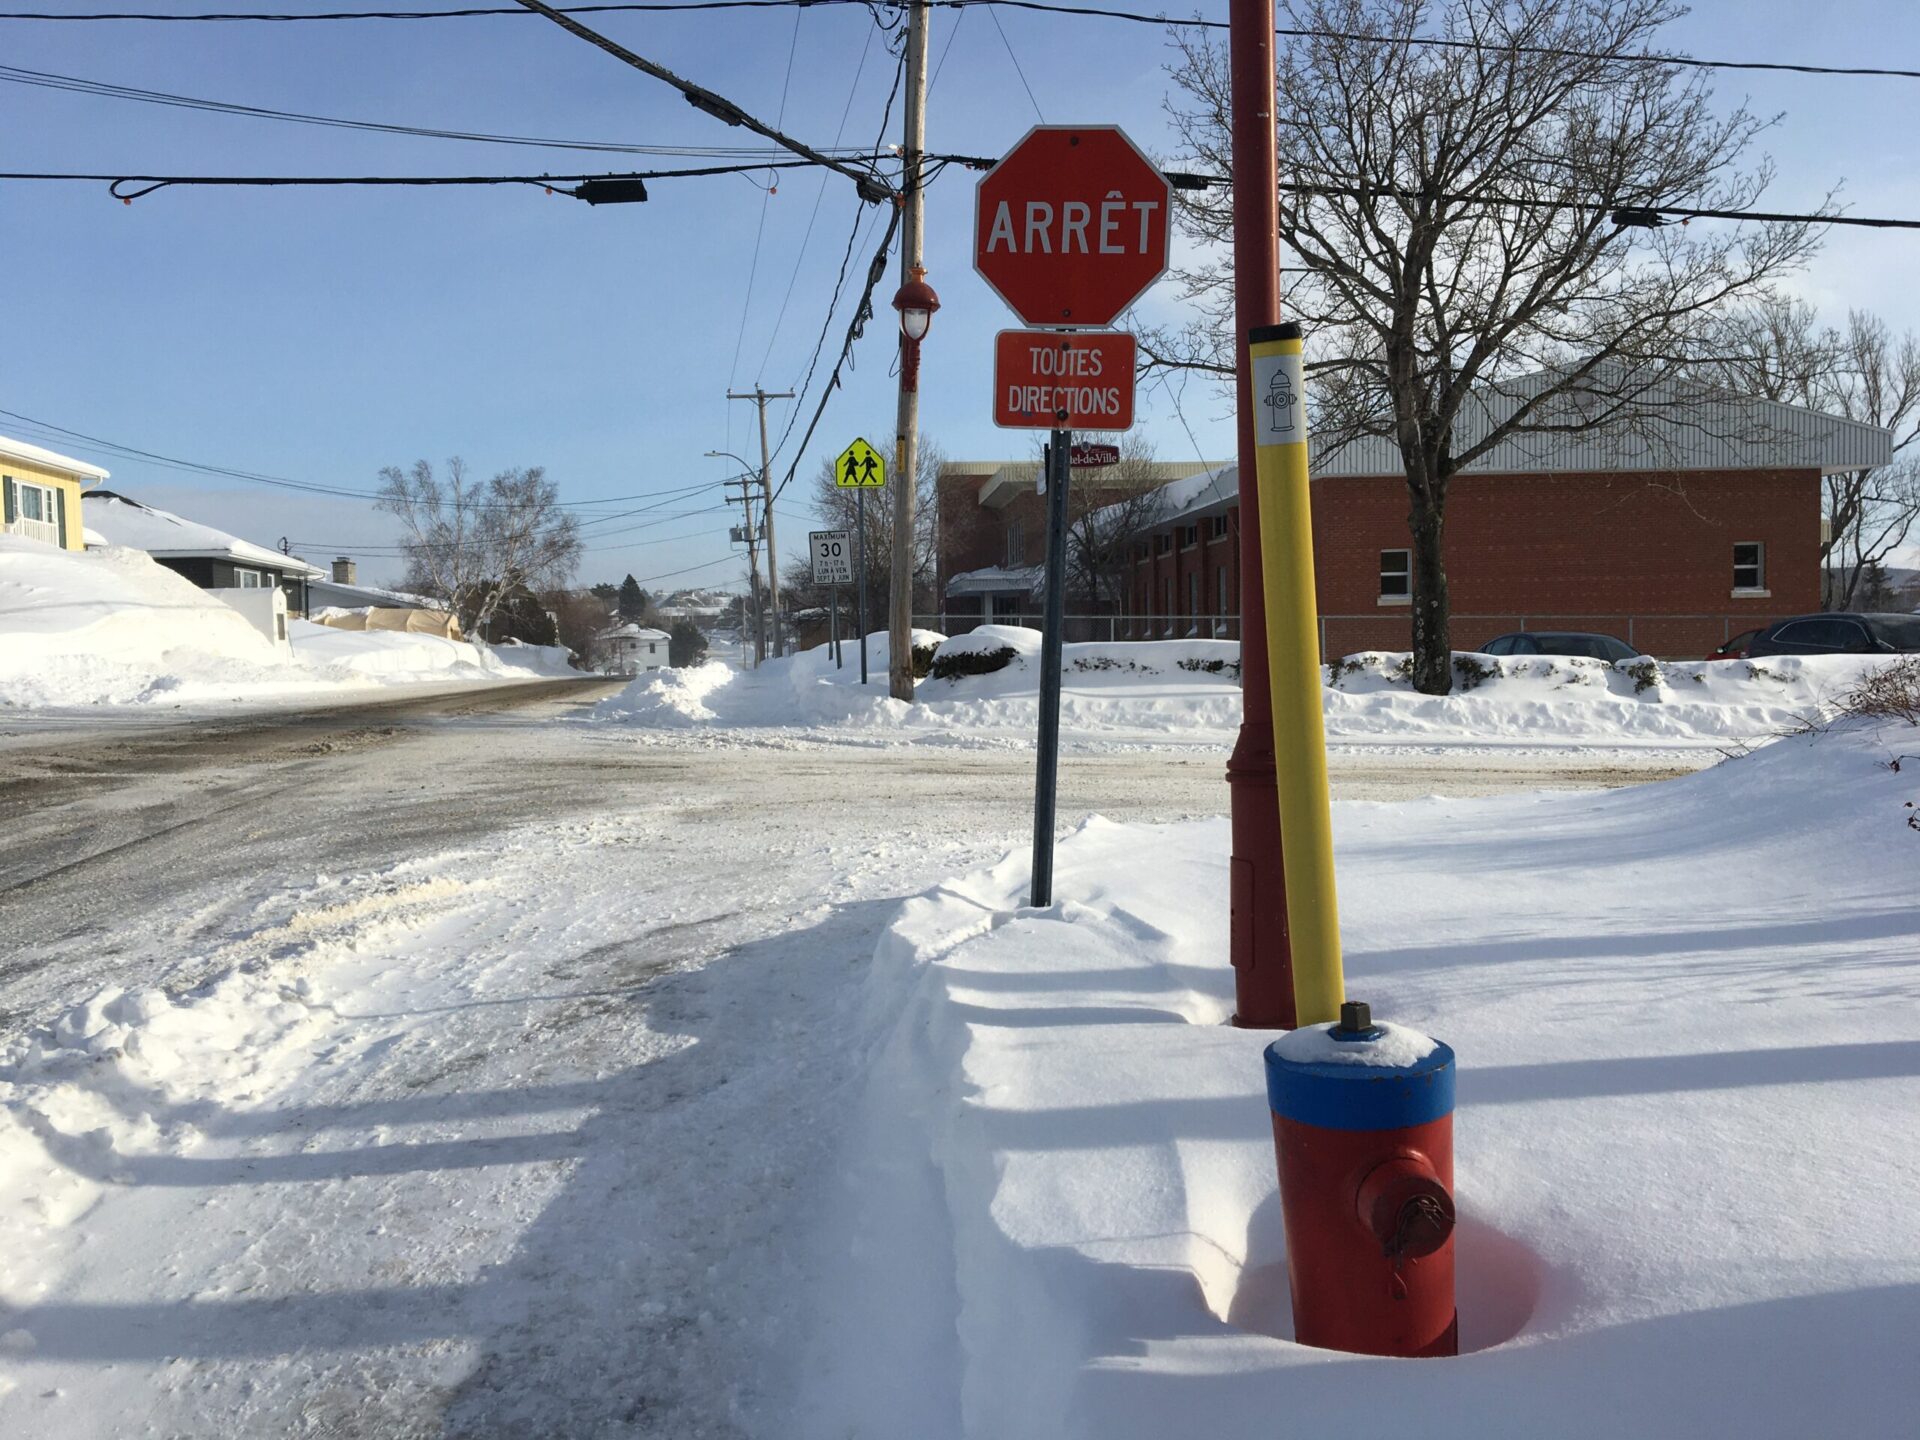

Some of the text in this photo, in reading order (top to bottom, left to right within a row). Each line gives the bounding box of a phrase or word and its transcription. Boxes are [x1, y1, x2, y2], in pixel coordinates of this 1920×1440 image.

[986, 190, 1159, 255] ARRÊT
[1029, 347, 1103, 377] TOUTES
[1008, 385, 1120, 415] DIRECTIONS
[820, 542, 842, 558] 30
[817, 567, 829, 575] LUN
[835, 566, 847, 574] VEN
